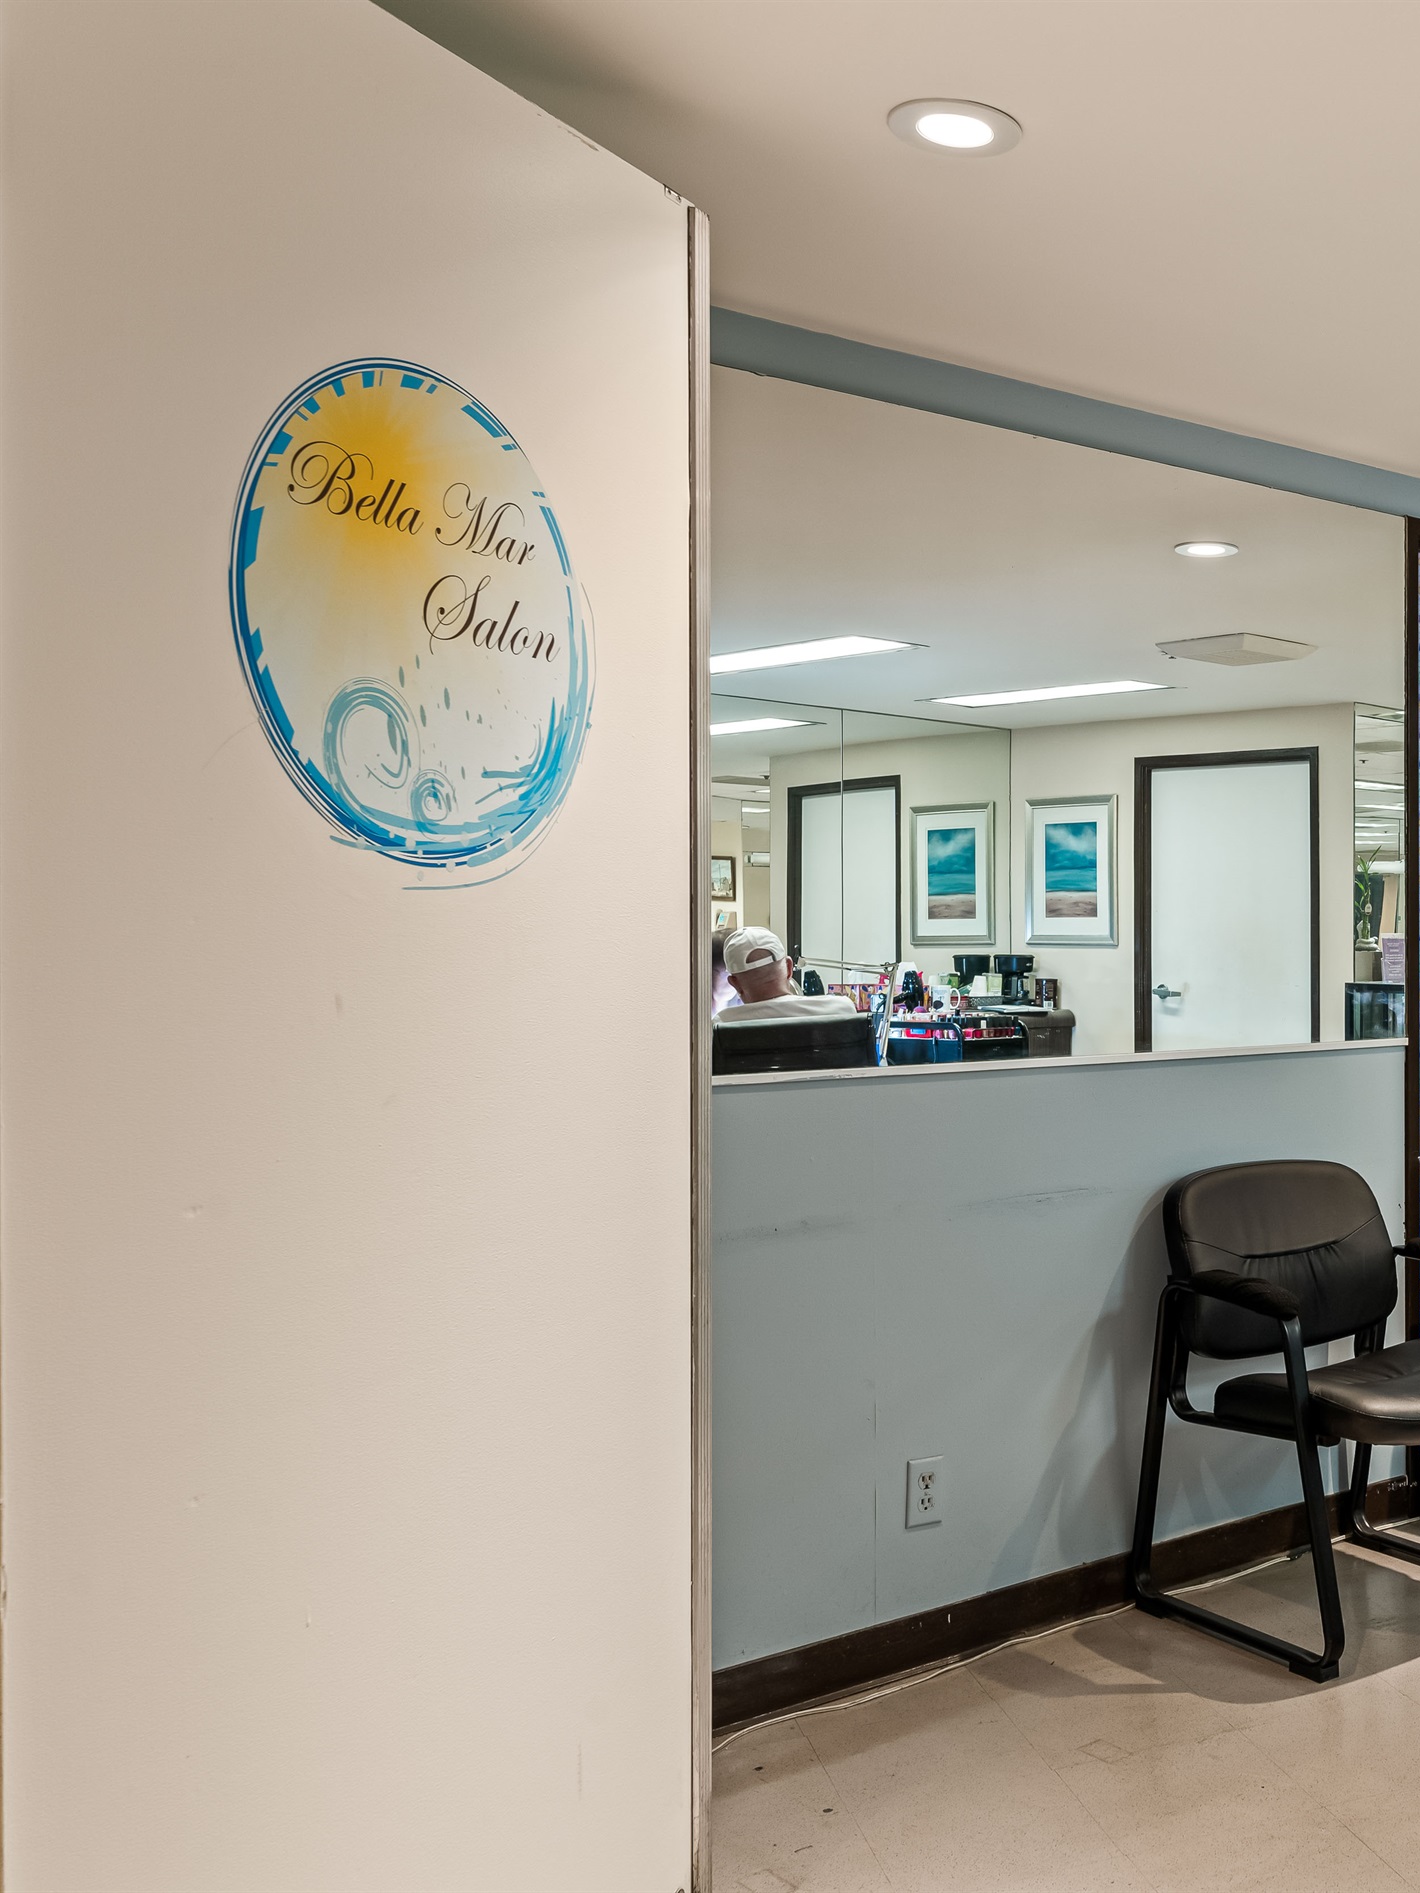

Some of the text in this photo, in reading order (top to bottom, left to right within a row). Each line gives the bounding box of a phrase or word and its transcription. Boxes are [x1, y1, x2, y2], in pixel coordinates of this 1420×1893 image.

[287, 440, 537, 566] Bella Mar
[422, 574, 561, 663] Salon
